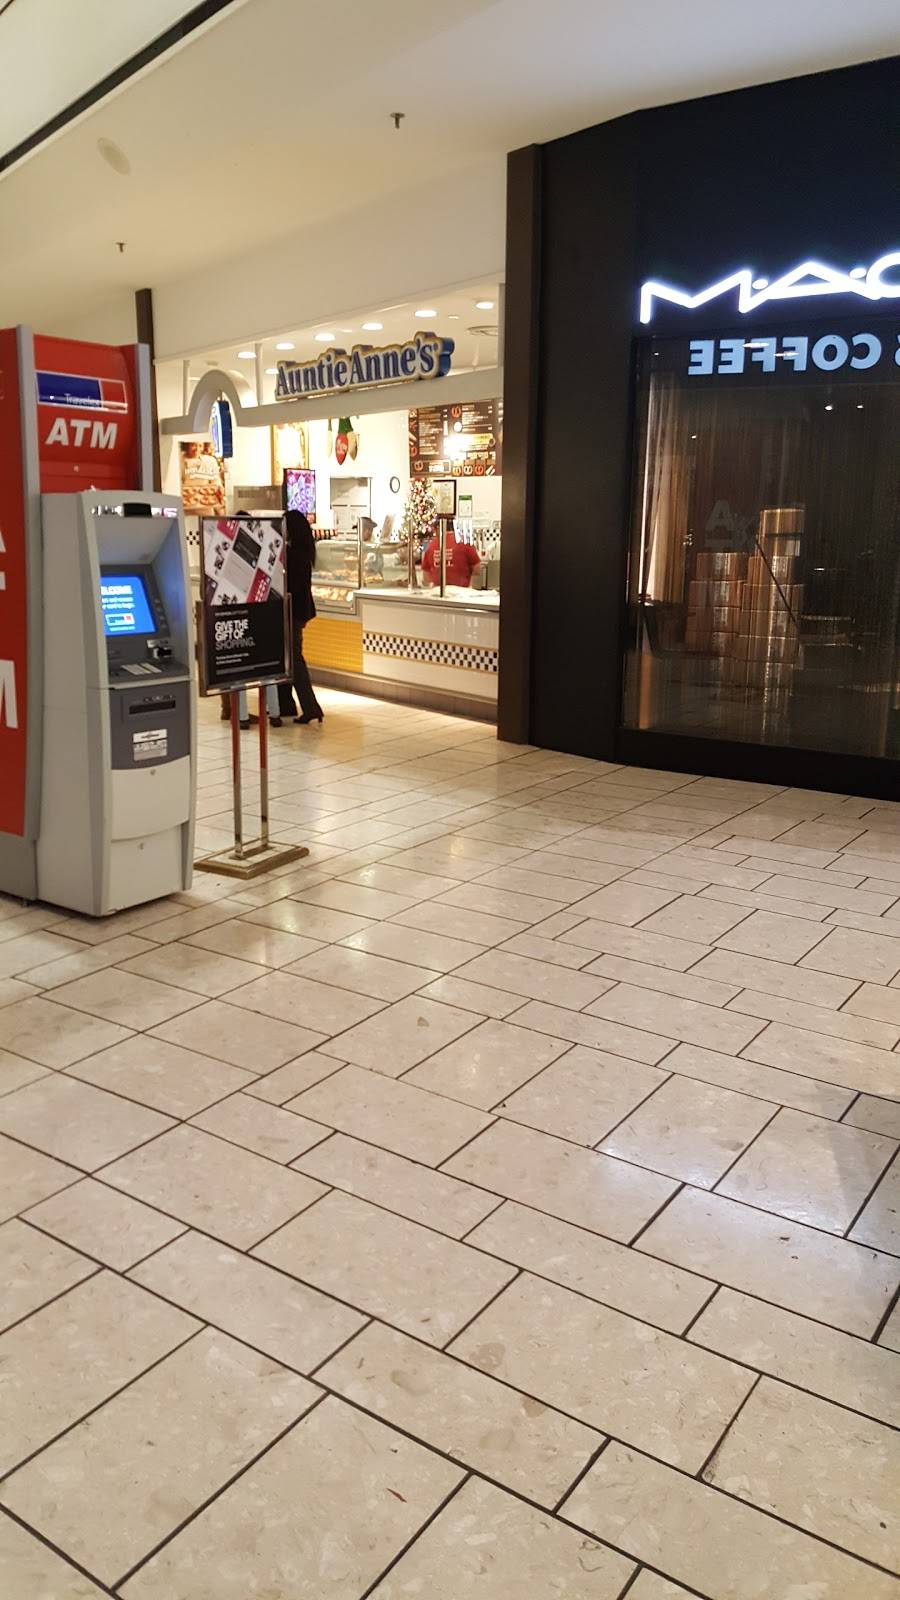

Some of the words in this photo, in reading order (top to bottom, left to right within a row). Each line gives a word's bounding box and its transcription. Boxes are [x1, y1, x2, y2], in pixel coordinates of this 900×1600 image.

[276, 353, 348, 397] Auntie
[349, 338, 436, 385] Anne's
[44, 417, 118, 450] ATM
[215, 621, 233, 631] GIVE
[234, 619, 249, 630] THE
[215, 629, 233, 641] GIFT
[233, 628, 245, 640] OF
